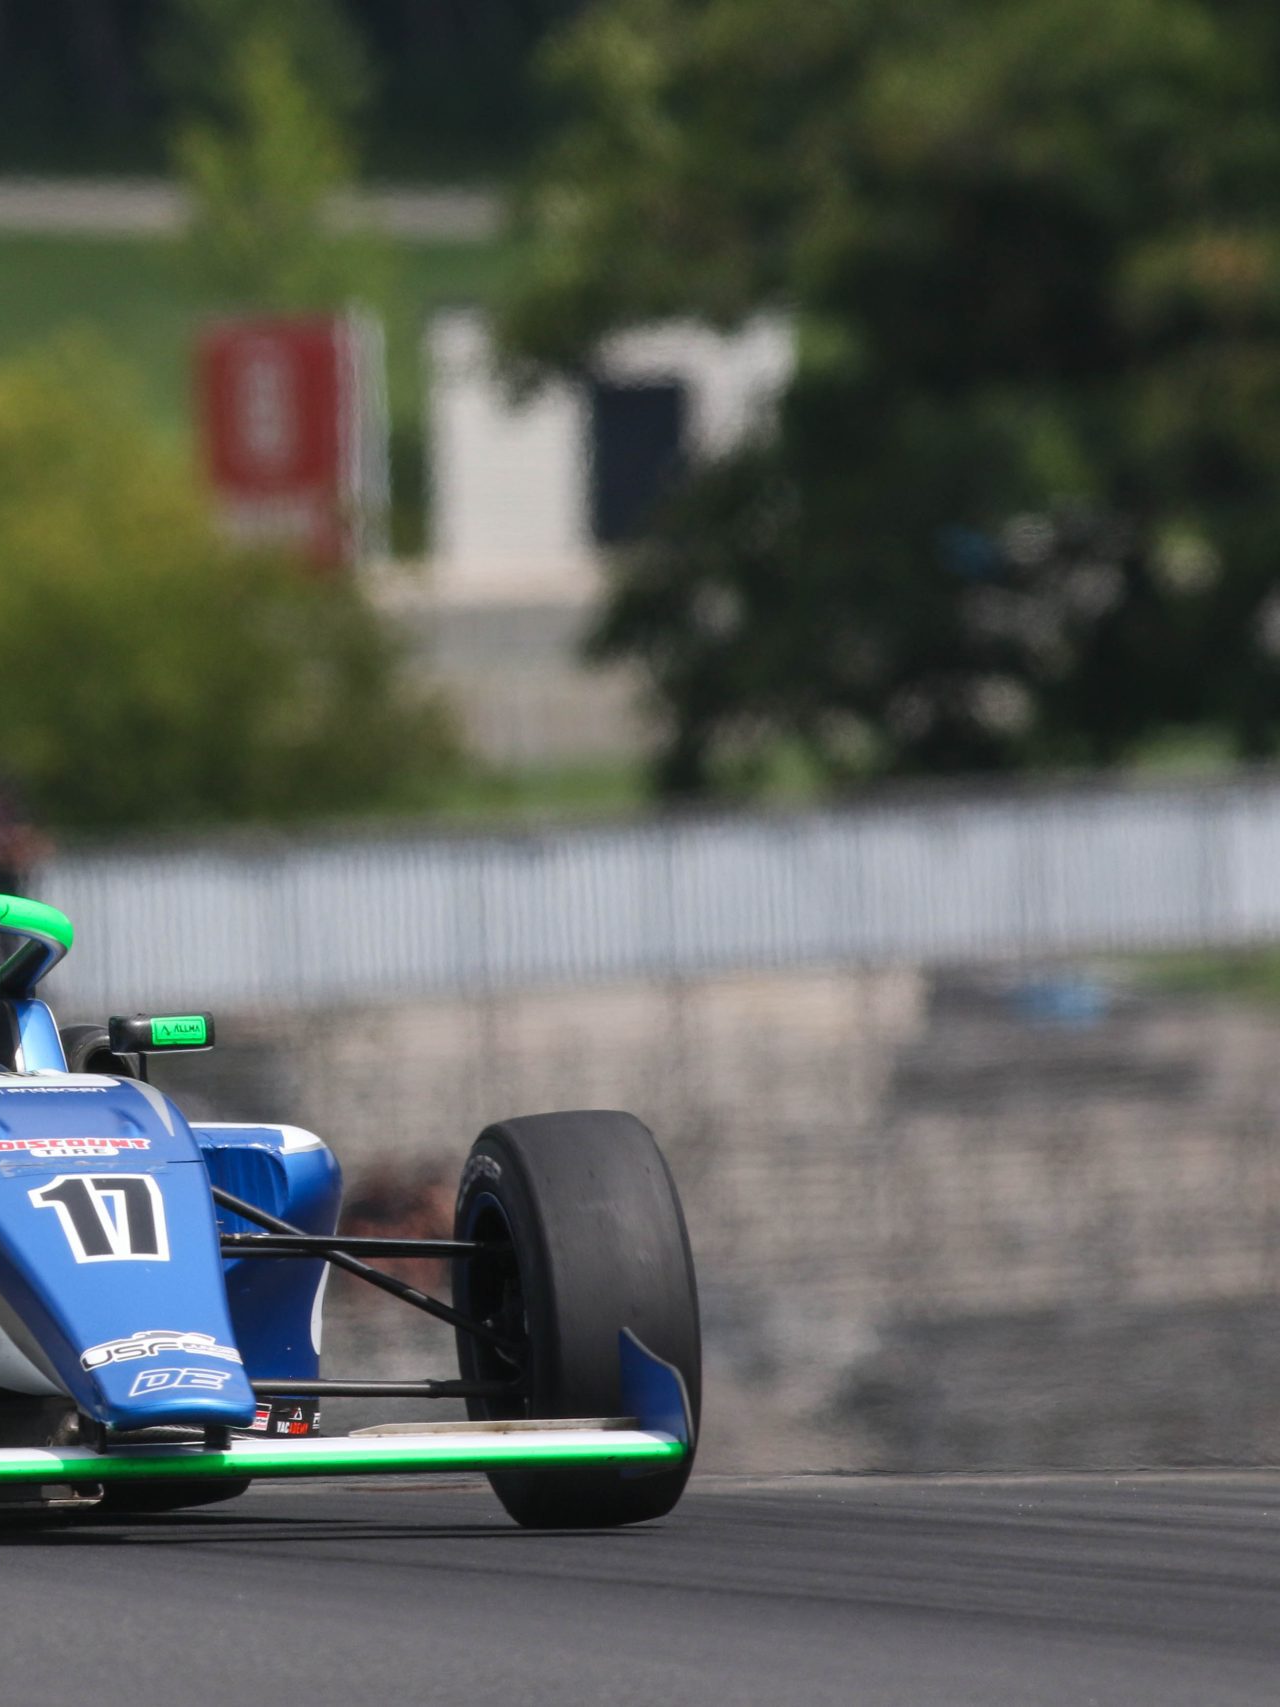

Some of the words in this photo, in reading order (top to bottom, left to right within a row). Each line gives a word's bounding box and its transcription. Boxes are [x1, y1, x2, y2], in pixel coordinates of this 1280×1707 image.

[173, 1023, 200, 1033] ALLMA
[40, 1148, 103, 1156] TIRE
[27, 1173, 170, 1264] 17
[81, 1340, 181, 1372] USF
[129, 1367, 232, 1398] DE
